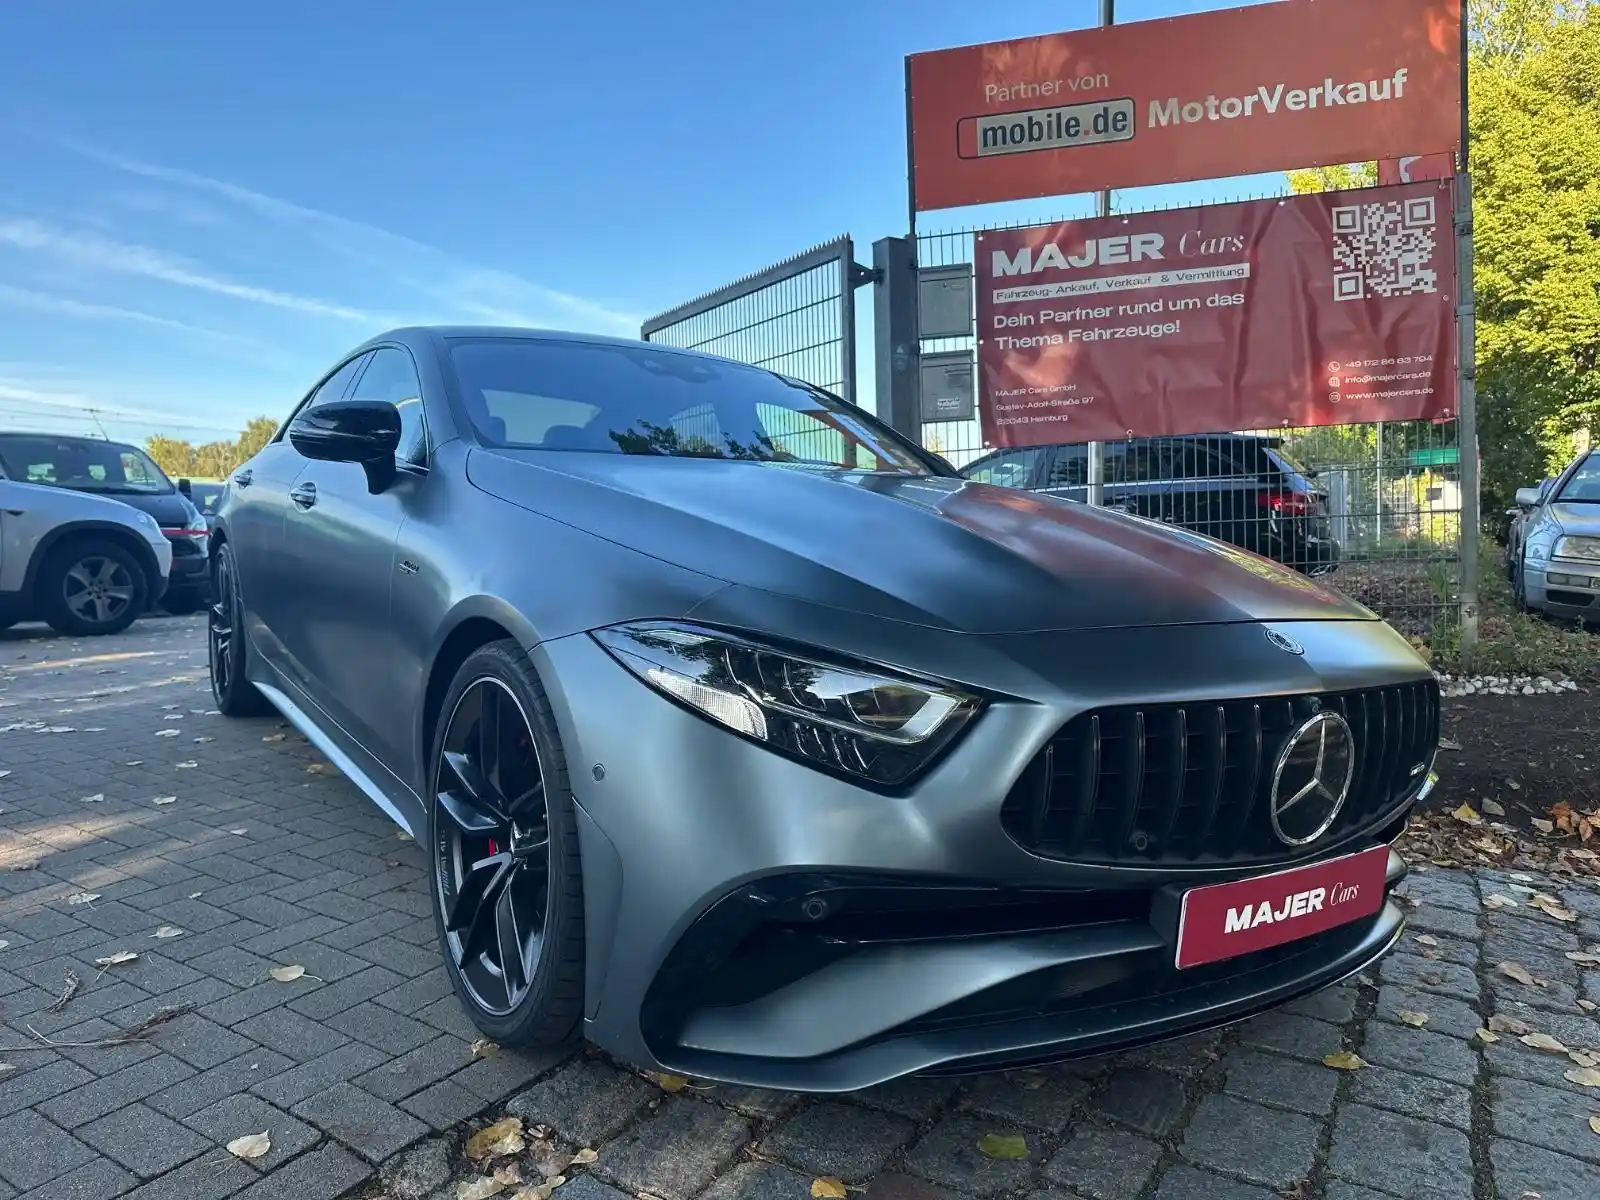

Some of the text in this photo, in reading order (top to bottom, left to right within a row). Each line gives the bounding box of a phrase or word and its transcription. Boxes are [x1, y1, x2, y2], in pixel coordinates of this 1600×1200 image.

[985, 73, 1109, 103] Partner von
[983, 68, 1408, 148] mobile.de MotorVerkauf
[992, 230, 1245, 278] MAJER Cars
[1105, 276, 1152, 288] Verkauf
[1160, 274, 1170, 283] &
[1176, 266, 1245, 282] Vermittlung
[993, 292, 1245, 329] Dein Partner rund um das
[994, 320, 1181, 350] Thema Fahrzeuge!
[995, 388, 1027, 397] MAJER
[1049, 384, 1077, 393] GmbH
[1345, 370, 1431, 384] info@majercars.de
[1345, 386, 1434, 400] www.majercars.de
[1030, 414, 1068, 422] Hamburg
[1224, 881, 1360, 934] MAJER Cars
